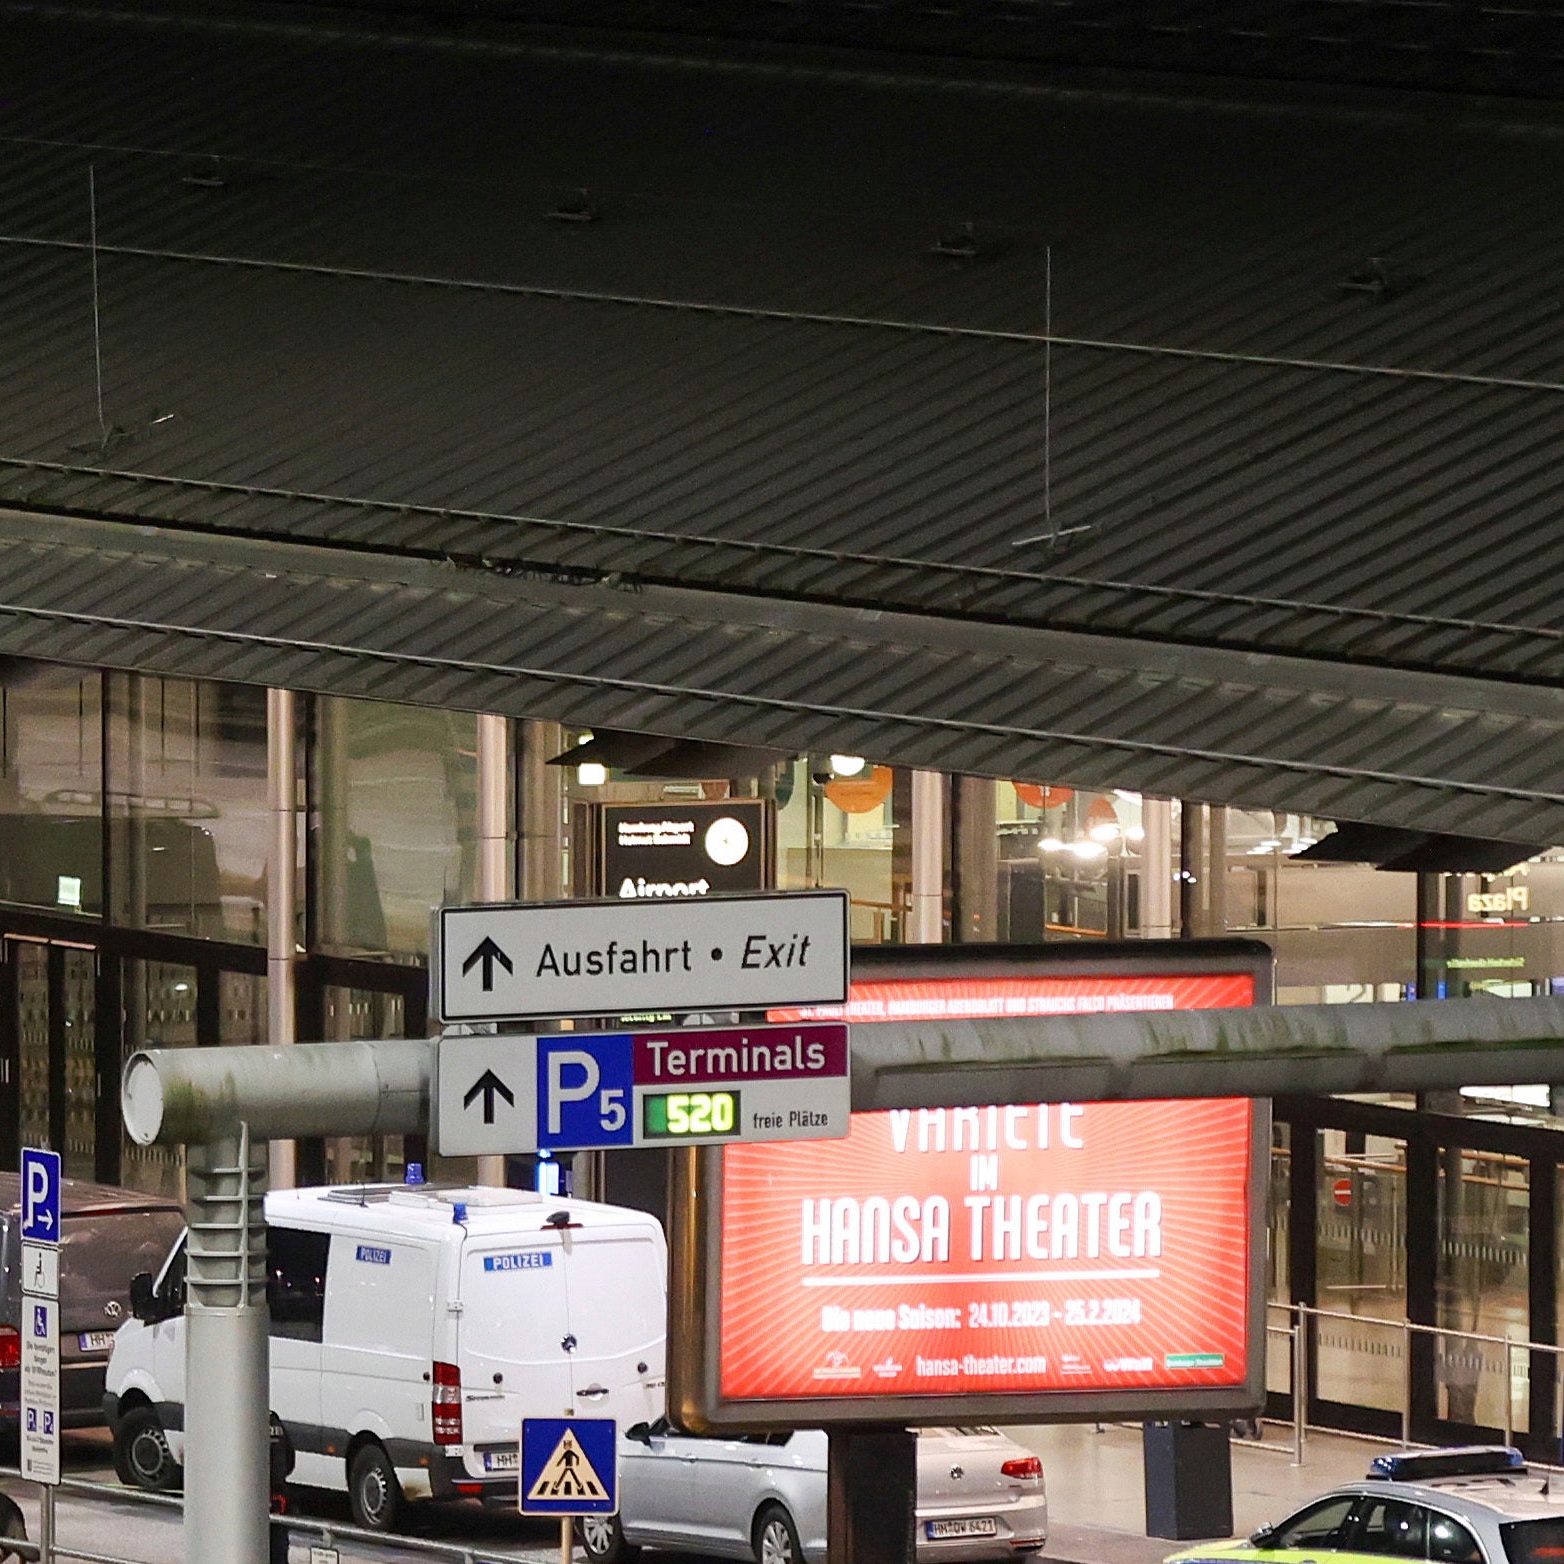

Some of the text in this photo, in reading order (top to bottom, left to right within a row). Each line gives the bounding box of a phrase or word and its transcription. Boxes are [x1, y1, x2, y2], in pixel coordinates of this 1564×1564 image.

[537, 935, 811, 977] Ausfahrt Exit
[647, 1036, 826, 1076] Terminals
[666, 1093, 734, 1134] 520
[753, 1109, 828, 1129] freie Plätze
[969, 1154, 998, 1190] IM
[25, 1161, 49, 1229] P
[802, 1192, 1163, 1264] HANSA THEATER
[359, 1247, 388, 1264] POLIZEI
[492, 1255, 545, 1270] POLIZEI
[821, 1306, 850, 1332] Die
[897, 1303, 961, 1330] Saison:
[968, 1301, 1050, 1328] 24.10.2023
[1064, 1299, 1141, 1326] 25.2.2024
[915, 1355, 1046, 1377] hansa-theater.com
